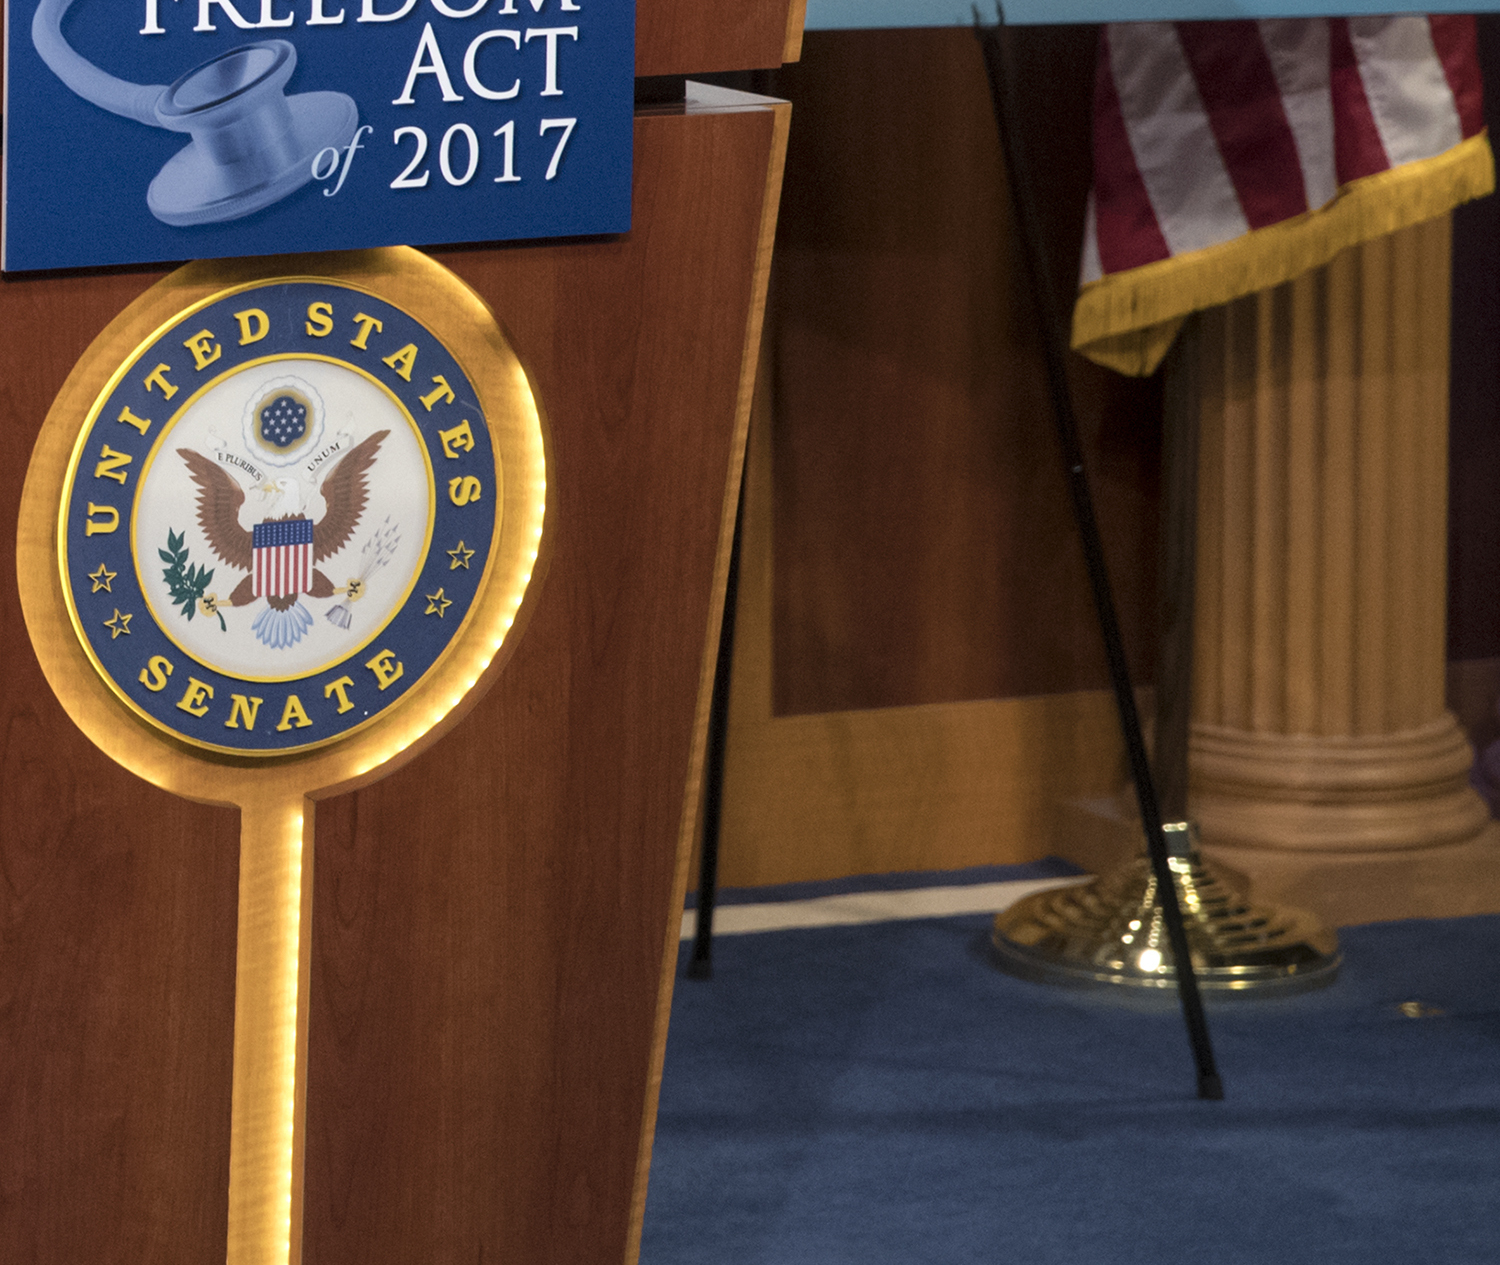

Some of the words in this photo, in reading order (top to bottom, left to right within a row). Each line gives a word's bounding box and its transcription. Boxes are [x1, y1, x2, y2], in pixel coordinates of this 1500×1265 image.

[392, 23, 578, 105] ACT
[310, 125, 373, 197] of
[390, 118, 577, 189] 2017
[85, 307, 271, 536] UNITED
[304, 301, 483, 508] STATES
[217, 452, 224, 461] E
[225, 453, 263, 482] PLURIBUS
[307, 442, 341, 472] UNUM
[138, 648, 404, 733] SENATE
